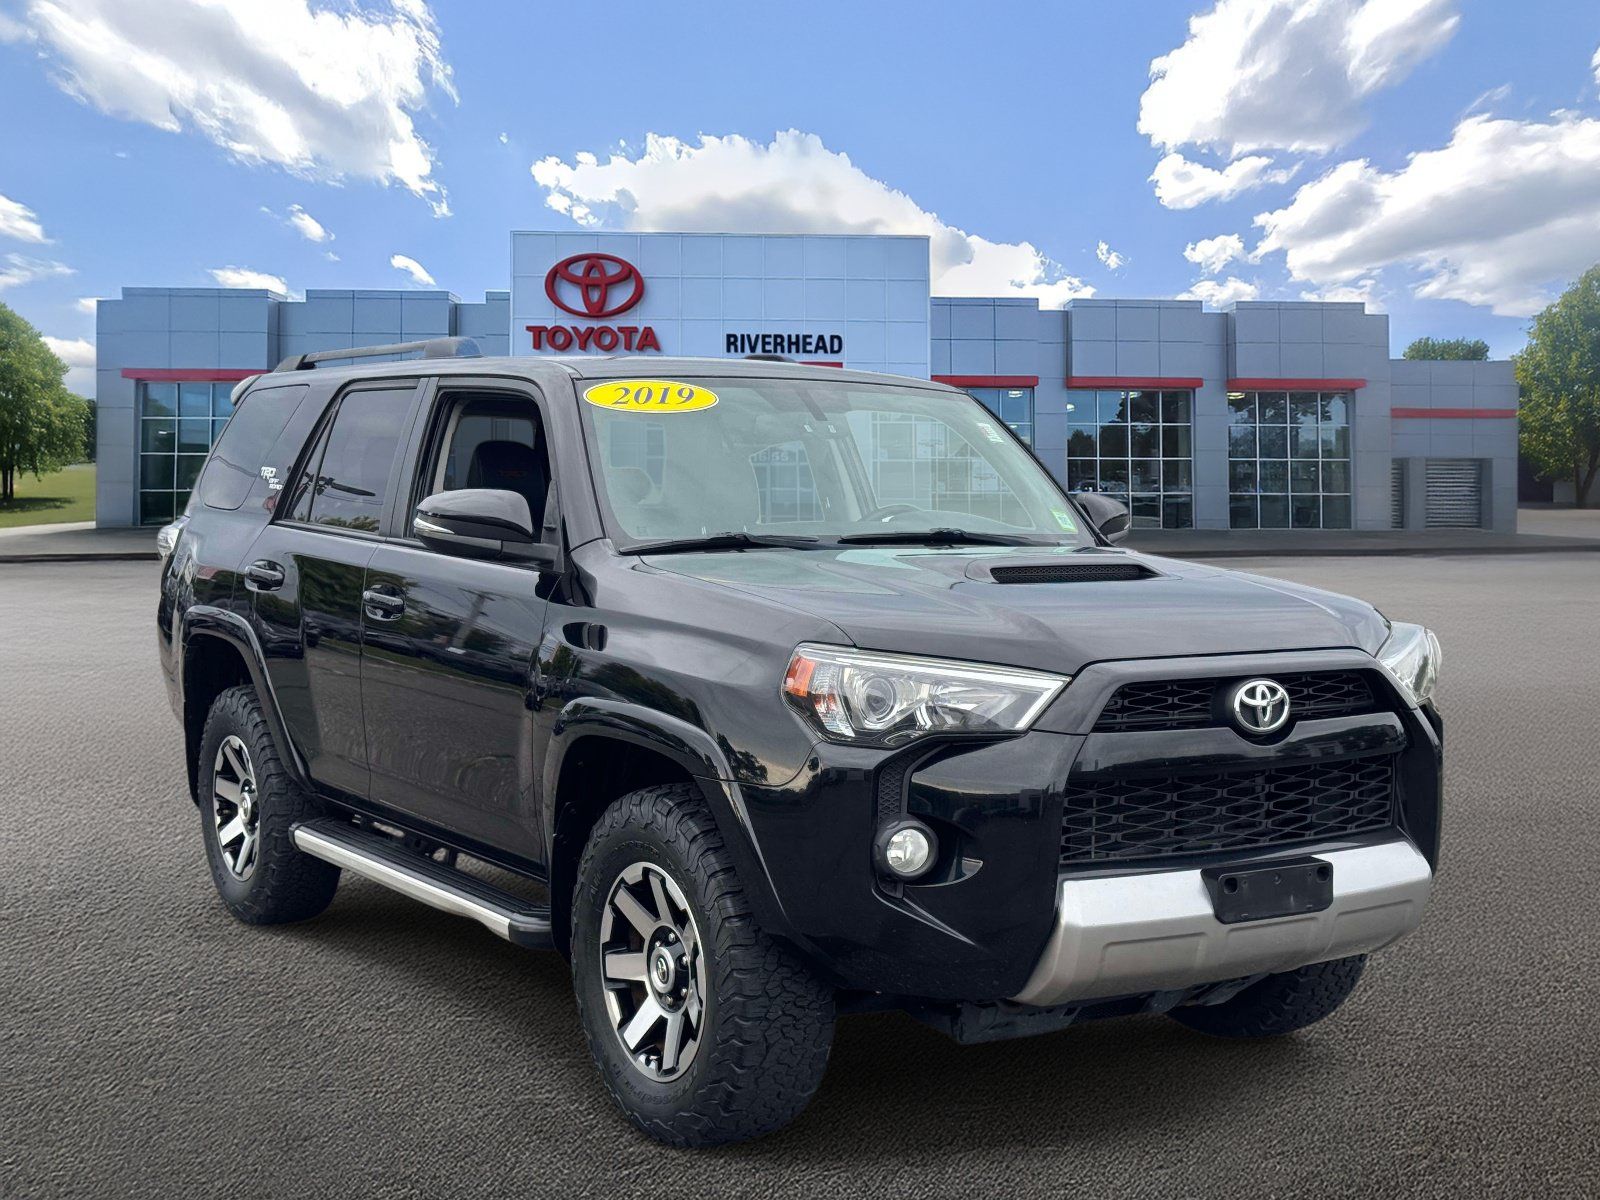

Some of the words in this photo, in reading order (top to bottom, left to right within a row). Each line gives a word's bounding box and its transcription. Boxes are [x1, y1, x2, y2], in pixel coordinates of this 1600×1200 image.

[526, 326, 661, 351] TOYOTA
[726, 334, 843, 354] RIVERHEAD
[612, 387, 695, 404] 2019
[261, 466, 276, 479] TRD
